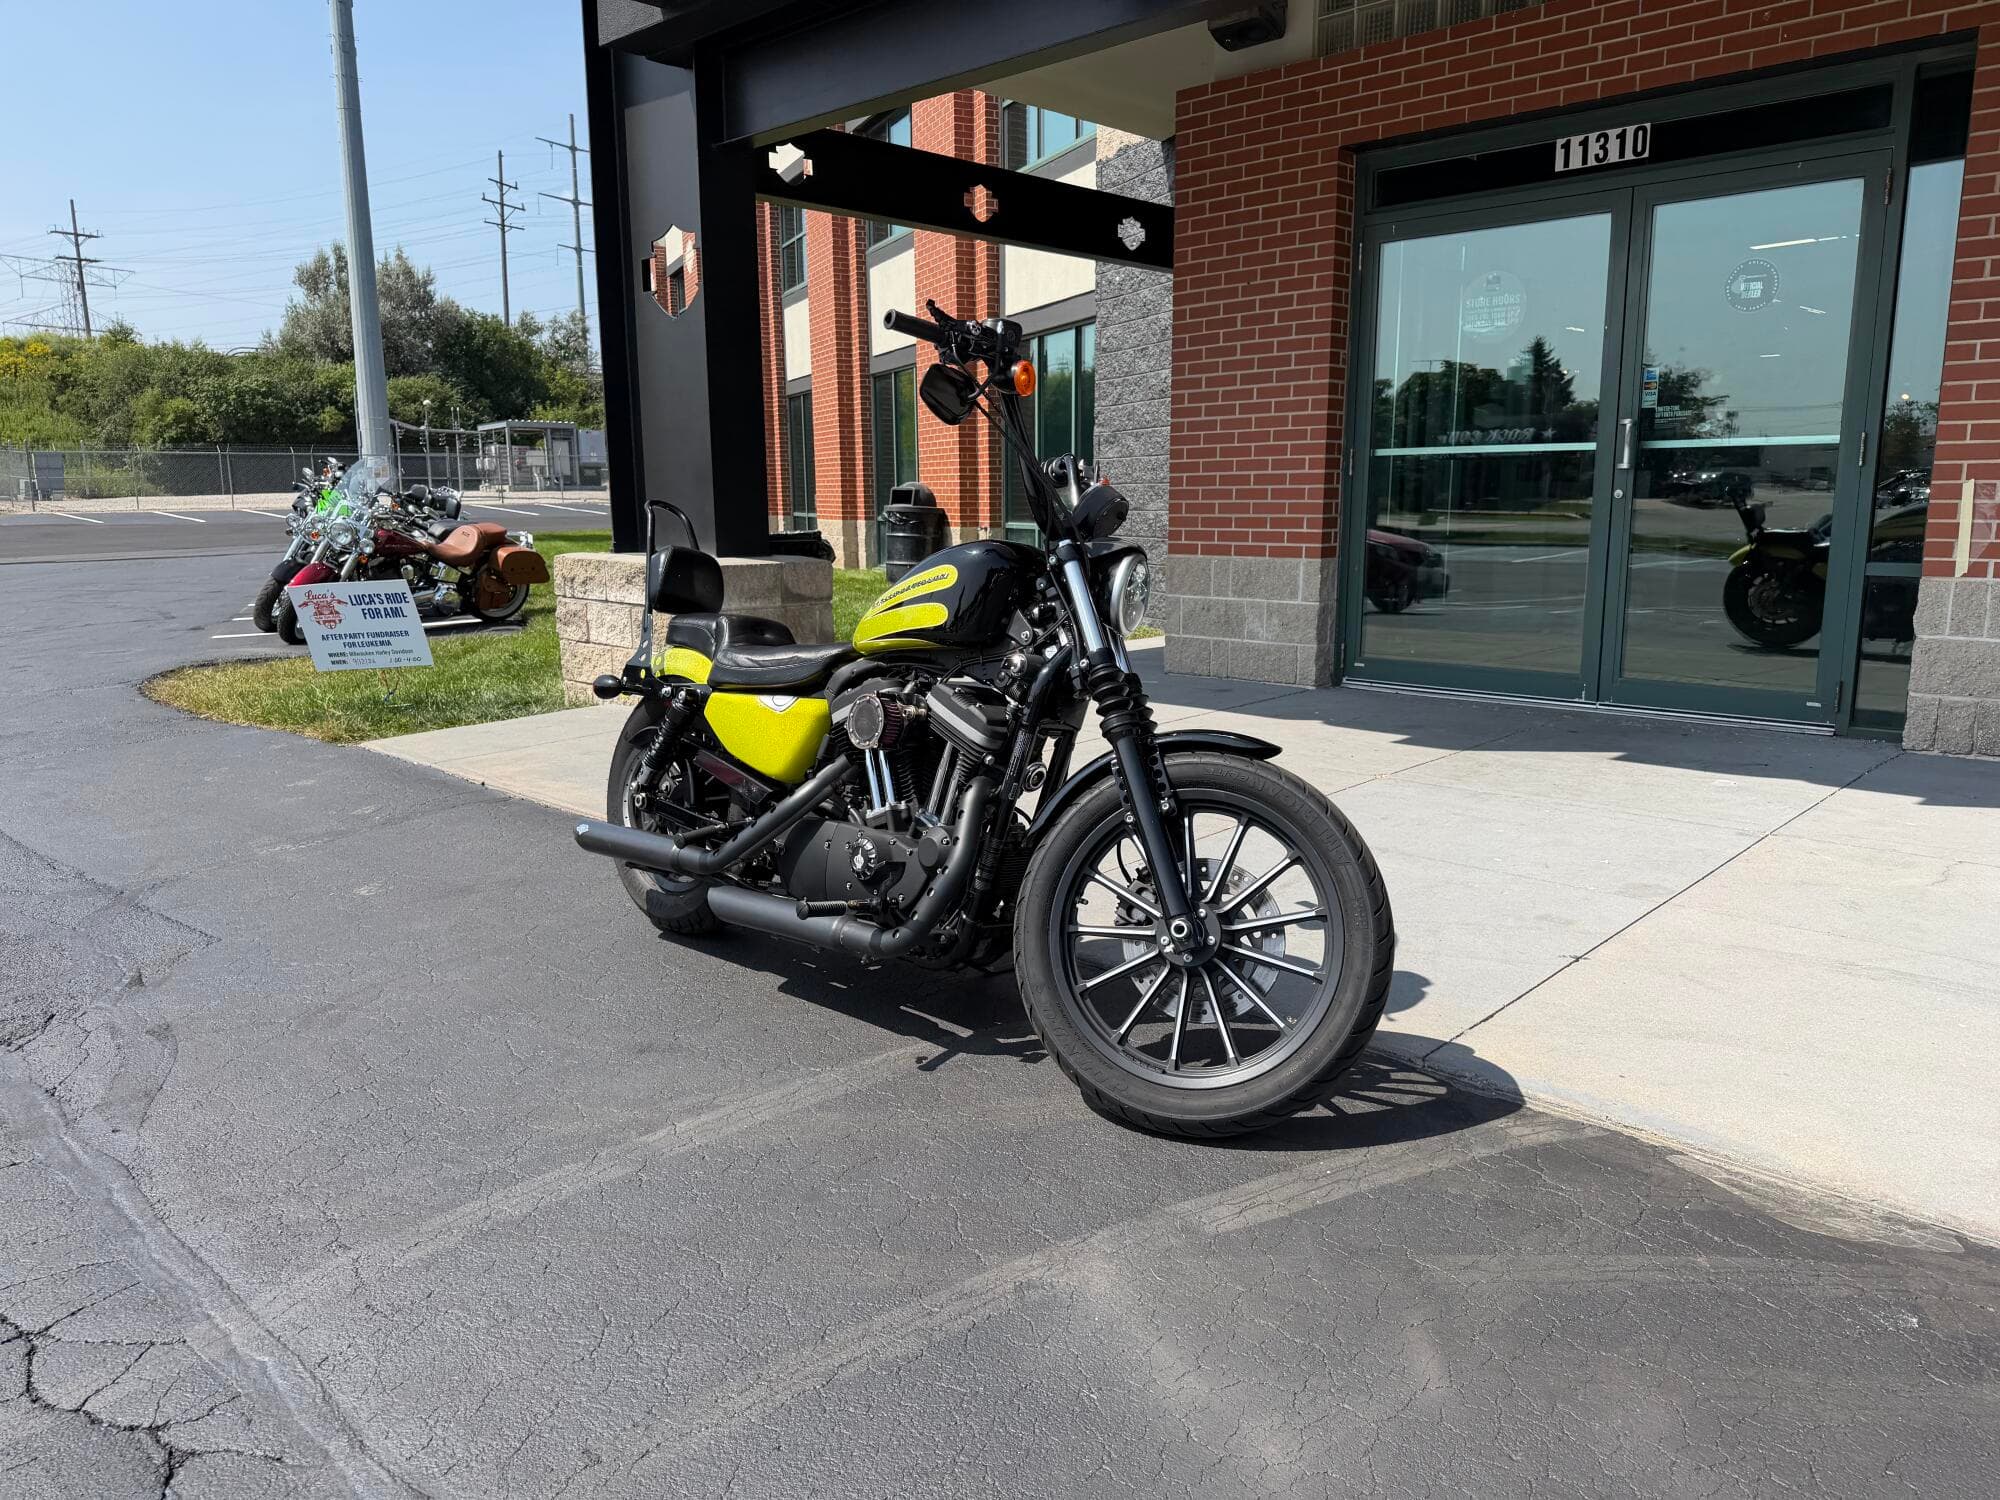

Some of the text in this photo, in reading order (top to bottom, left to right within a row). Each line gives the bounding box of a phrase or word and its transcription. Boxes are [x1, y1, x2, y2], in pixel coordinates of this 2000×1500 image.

[1560, 125, 1648, 168] 11310
[1492, 294, 1521, 306] HOURS
[305, 589, 336, 600] Luca's
[348, 592, 410, 606] LUCA'S RIDE
[361, 606, 408, 620] FOR AML
[321, 630, 410, 642] AFTER PARTY FUNDRAISER
[357, 640, 392, 648] LEUKEMIA
